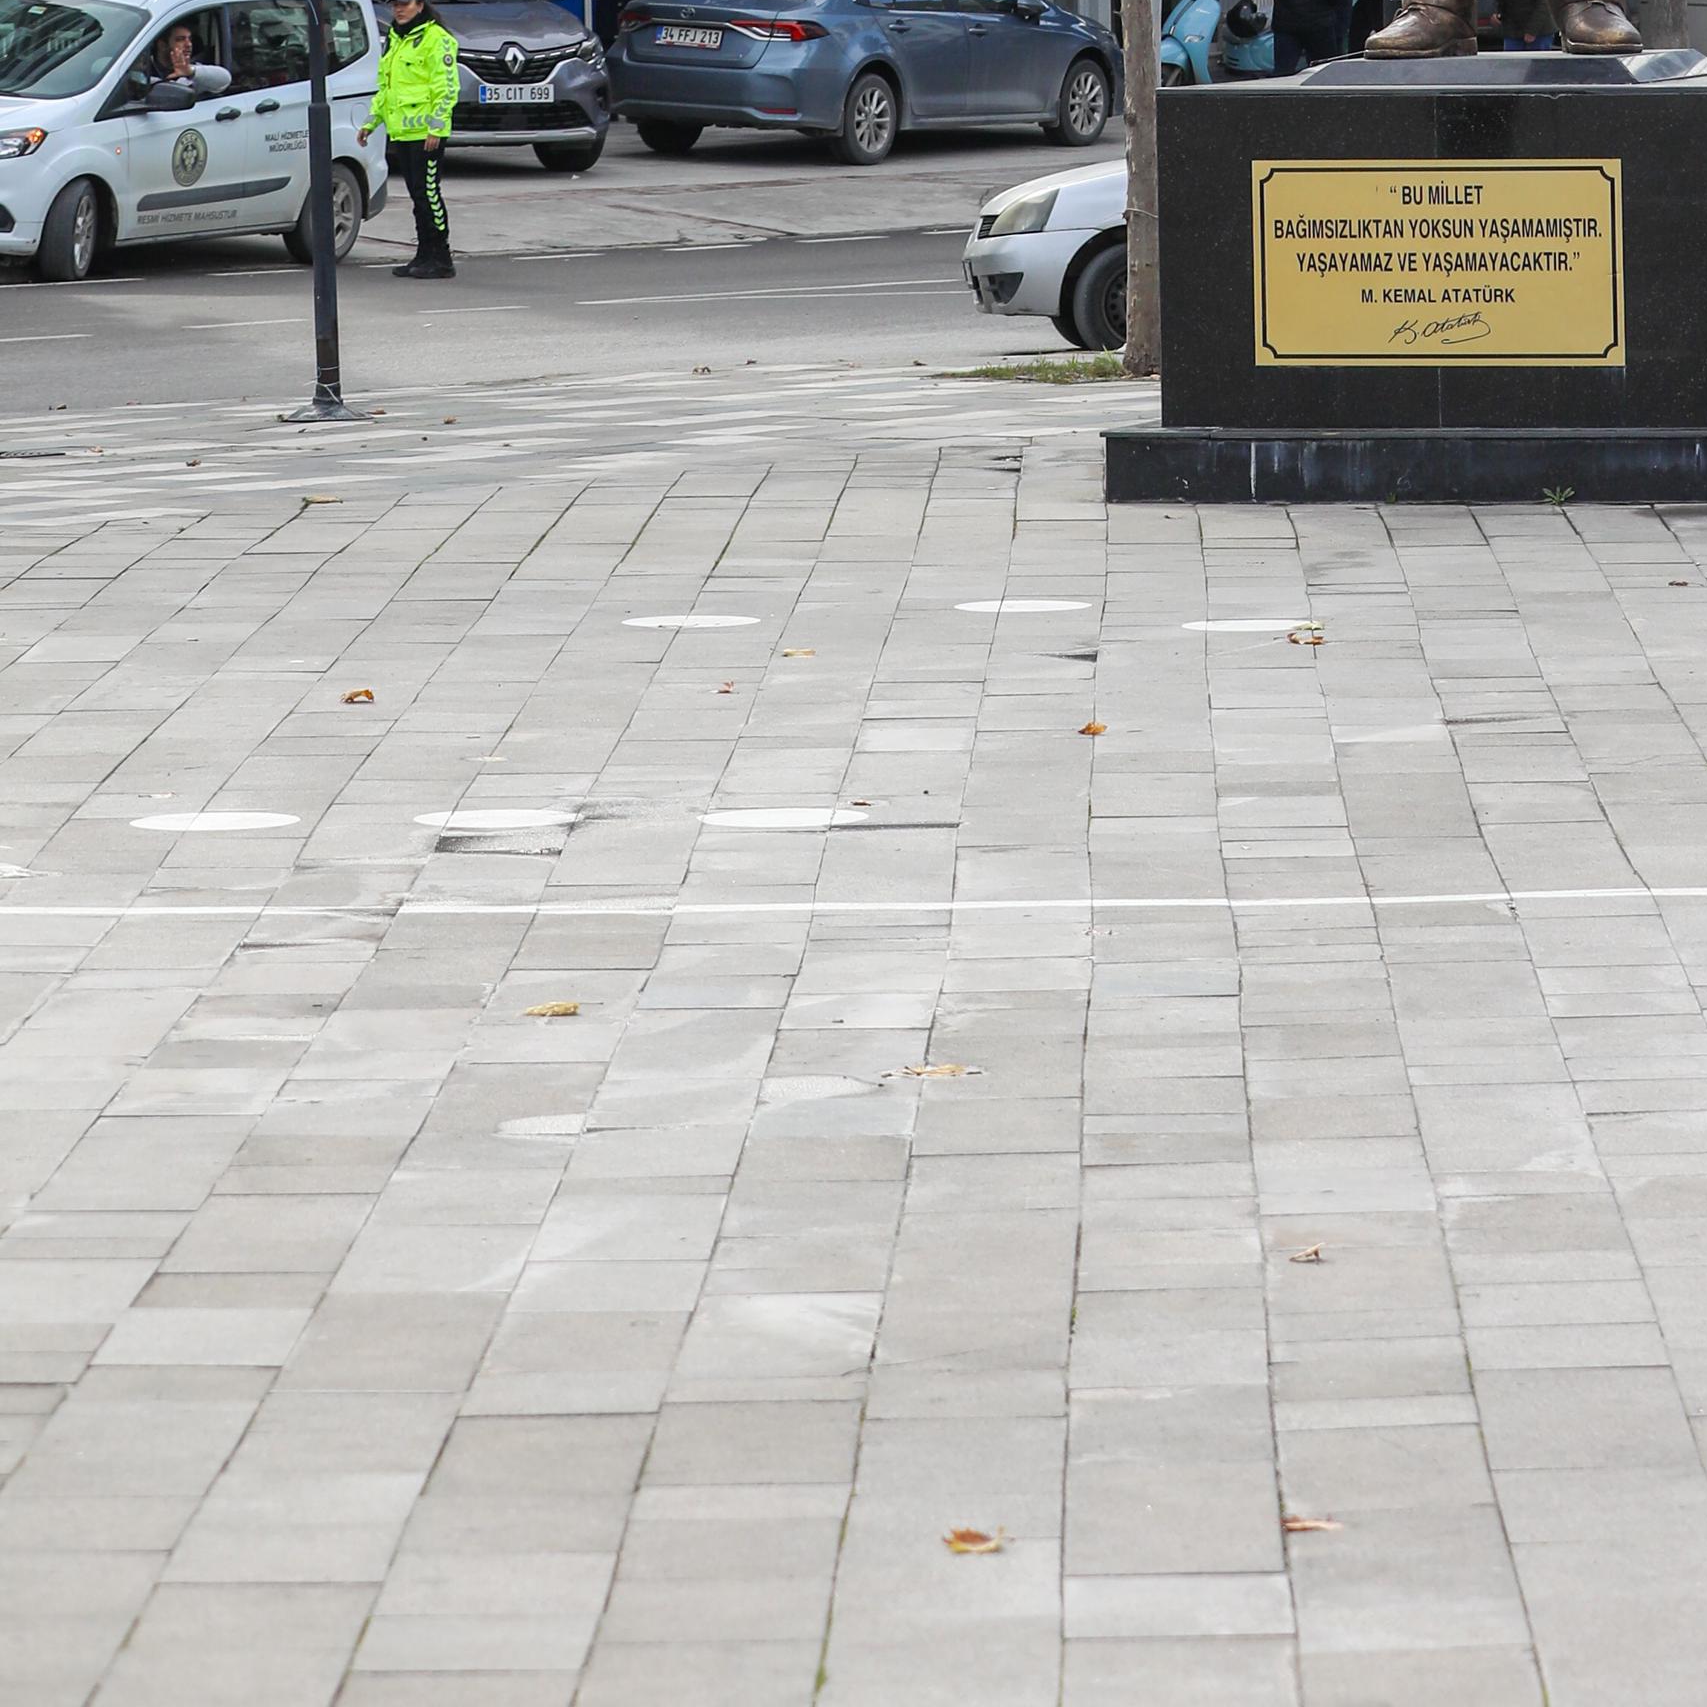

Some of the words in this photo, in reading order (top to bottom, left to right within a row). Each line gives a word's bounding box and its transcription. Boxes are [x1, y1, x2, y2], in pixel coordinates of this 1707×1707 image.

[662, 27, 675, 40] 34
[677, 27, 697, 43] FFJ
[700, 29, 720, 44] 213
[486, 86, 500, 100] 35
[506, 86, 524, 100] CIT
[530, 86, 550, 99] 699
[1428, 180, 1484, 205] MİLLET
[1274, 213, 1404, 239] BAĞIMSIZLIKTAN
[1409, 219, 1474, 239] YOKSUN
[1478, 218, 1603, 244] YAŞAMAMIŞTIR.
[1296, 252, 1393, 278] YAŞAYAMAZ
[1397, 252, 1418, 272] VE
[1361, 288, 1377, 303] M.
[1383, 288, 1437, 303] KEMAL
[1441, 285, 1516, 303] ATATÜRK
